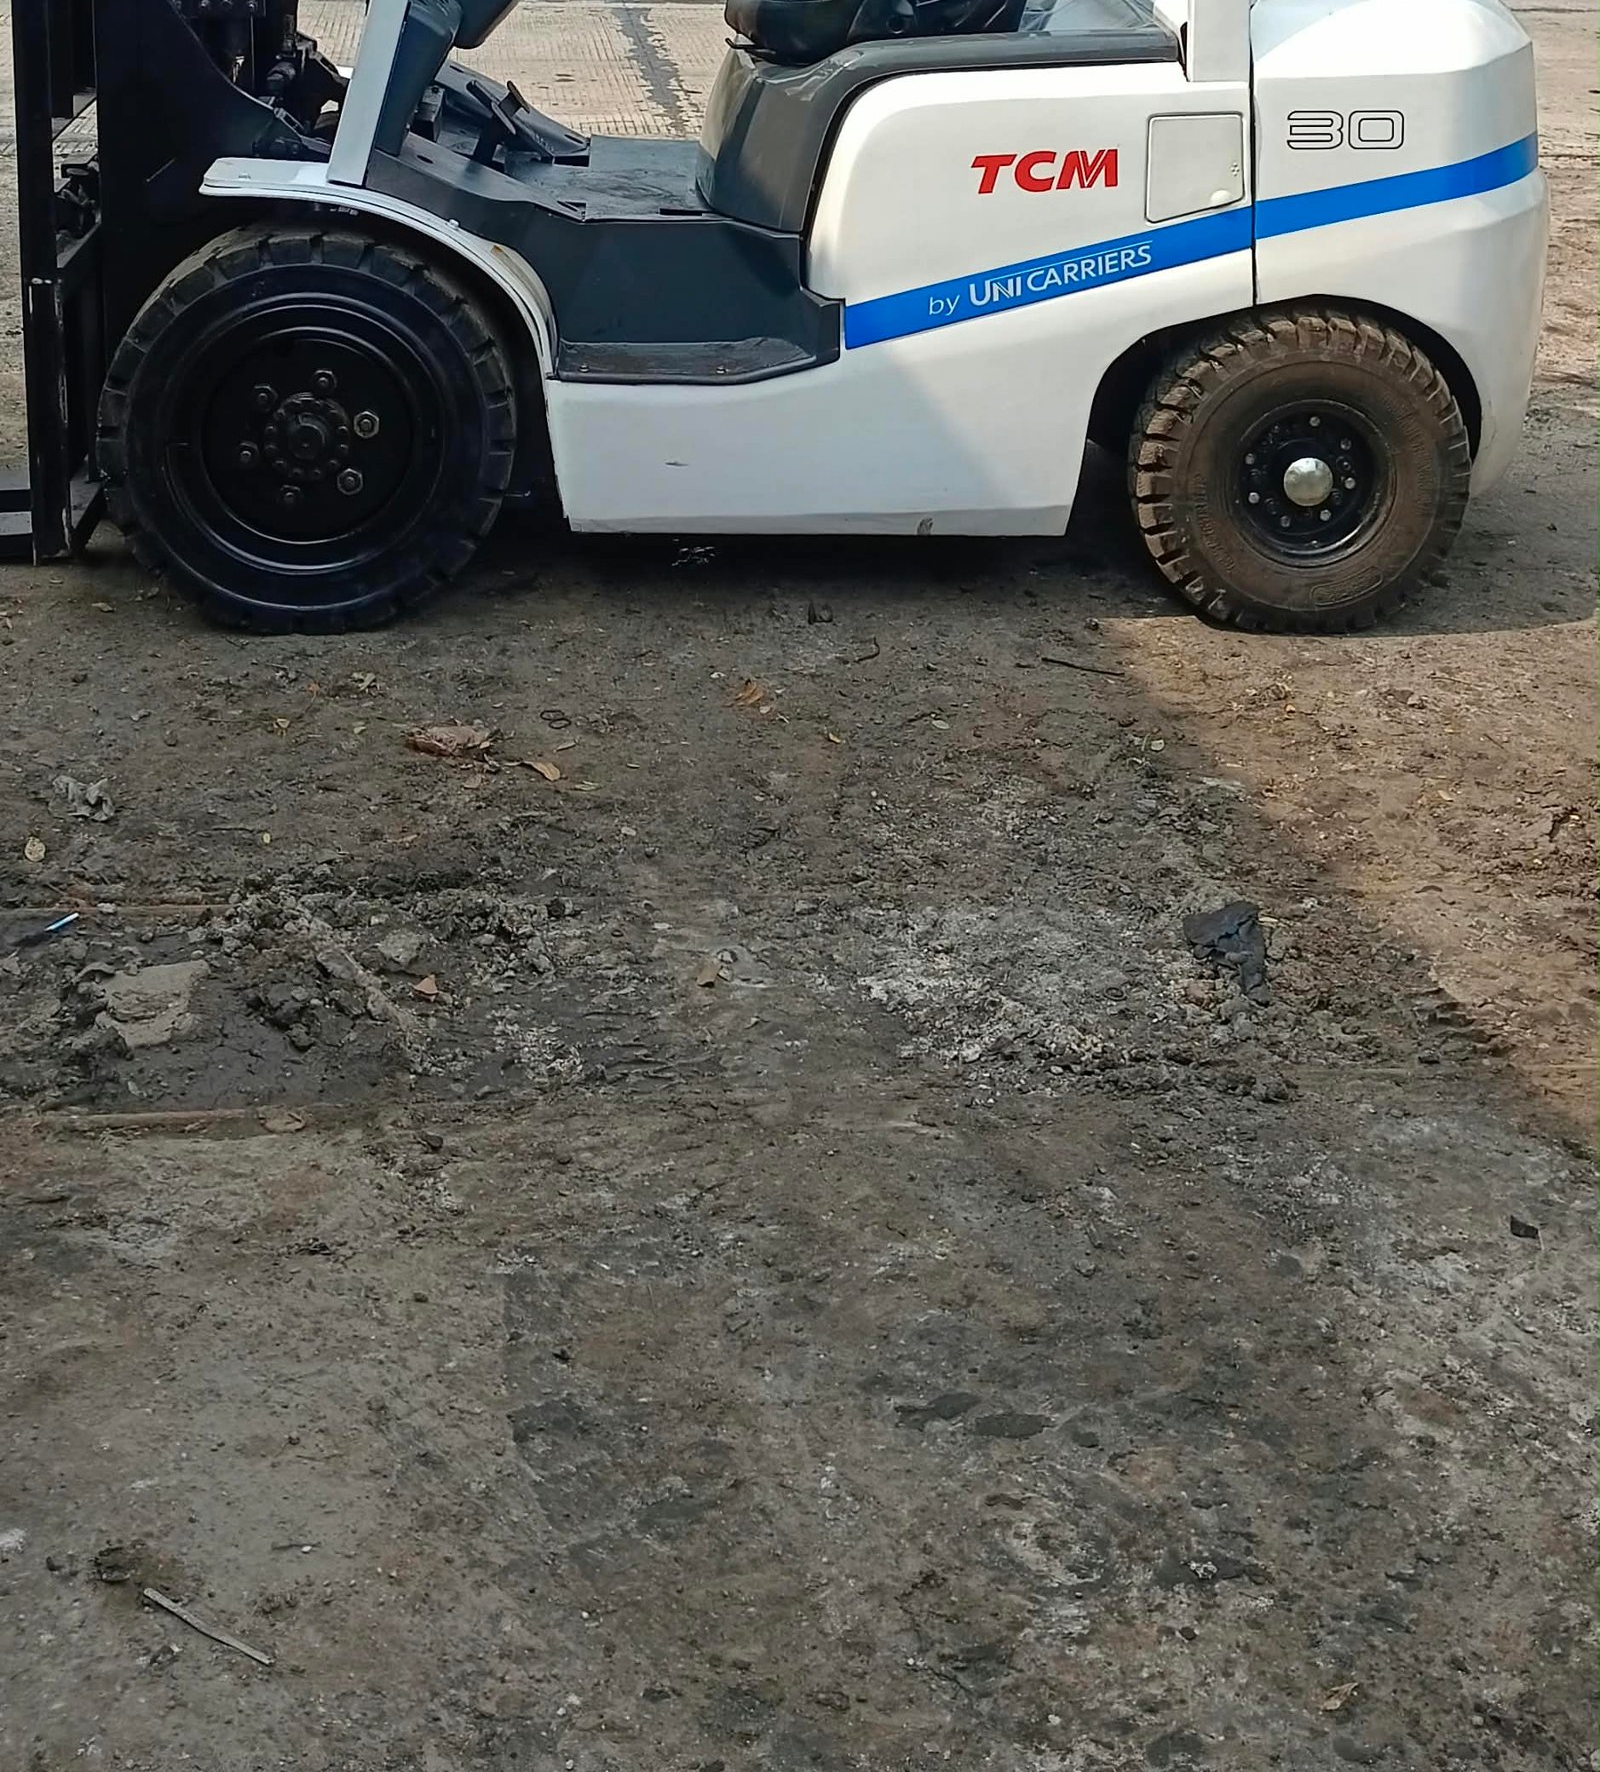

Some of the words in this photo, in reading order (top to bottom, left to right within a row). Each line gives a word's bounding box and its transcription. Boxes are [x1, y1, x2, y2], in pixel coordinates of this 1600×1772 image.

[1287, 110, 1404, 150] 30
[970, 148, 1119, 194] TCM
[928, 294, 961, 316] by
